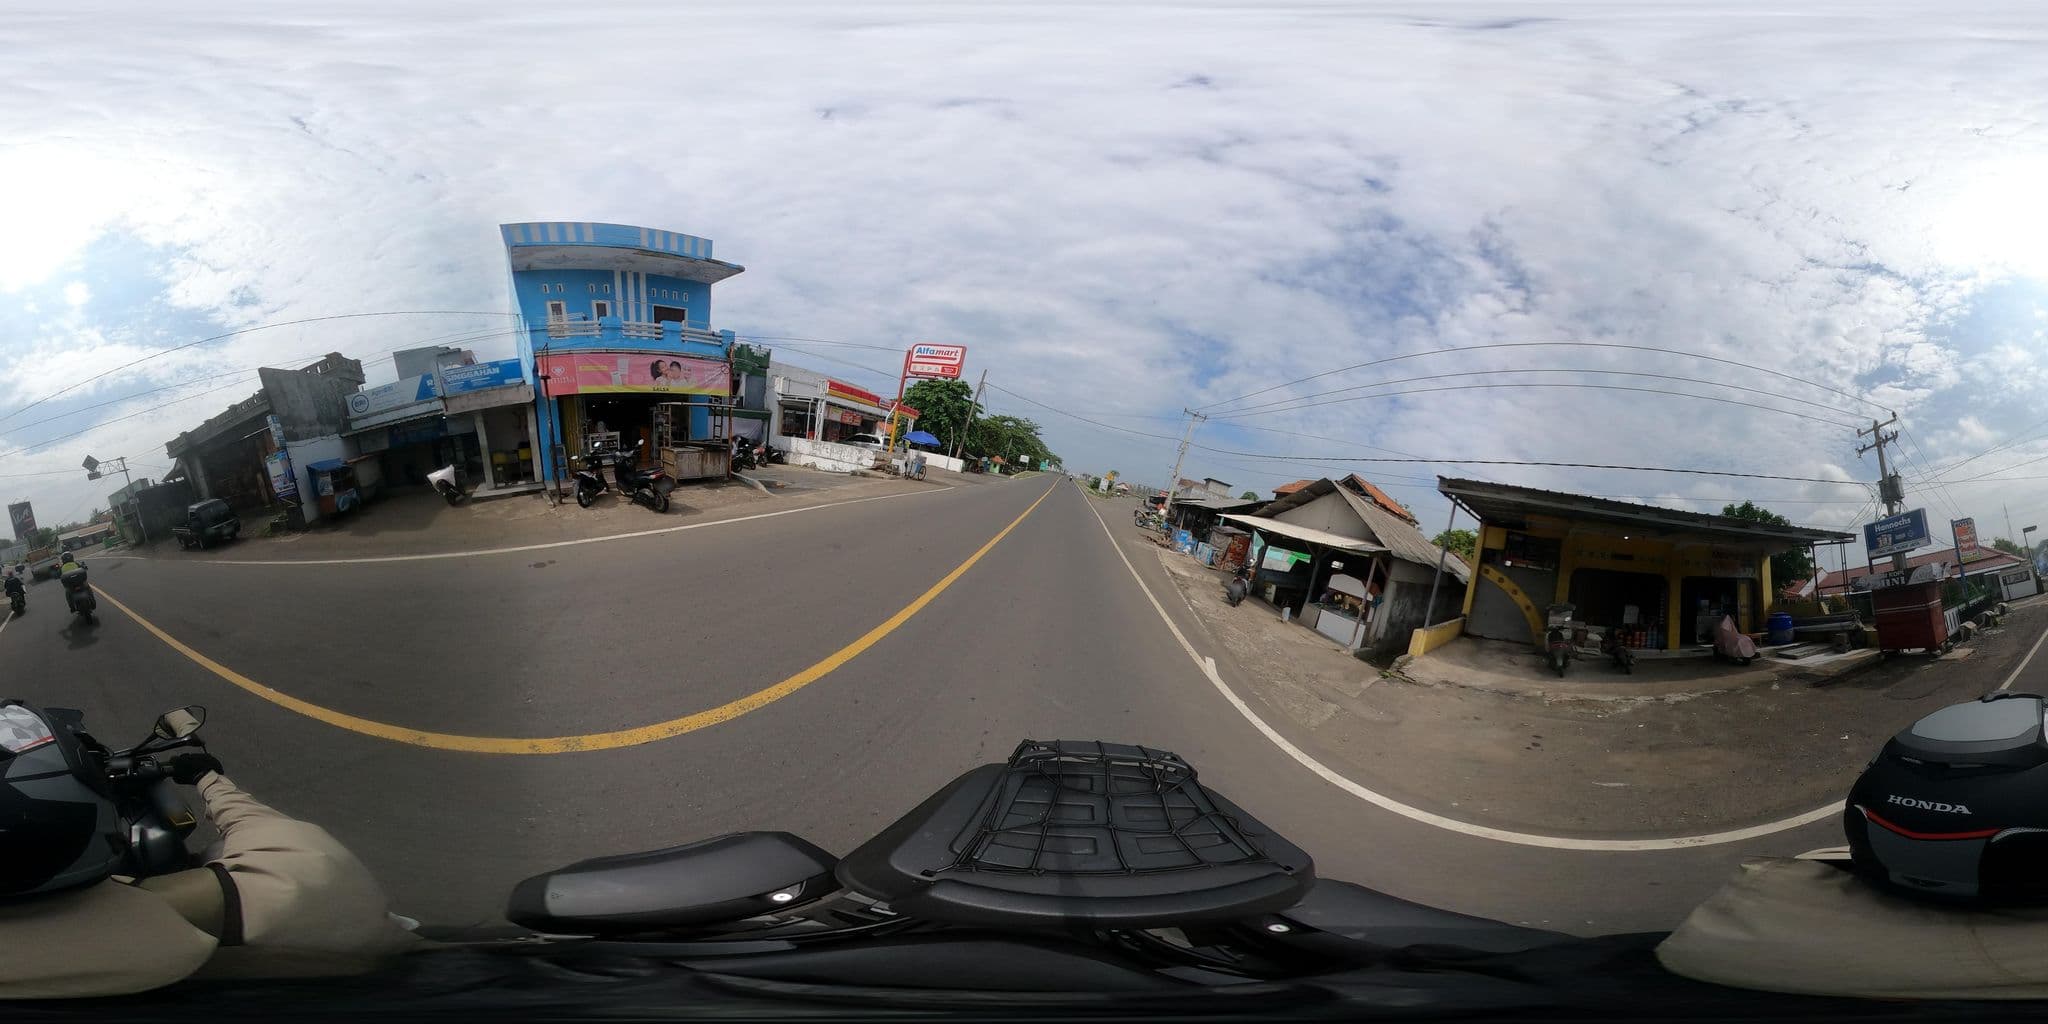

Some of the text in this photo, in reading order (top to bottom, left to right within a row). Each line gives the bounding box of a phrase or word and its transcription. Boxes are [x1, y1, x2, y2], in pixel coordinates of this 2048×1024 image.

[916, 346, 959, 357] Alfamart
[1875, 516, 1911, 533] Hannochs
[1887, 794, 1972, 815] HONDA
